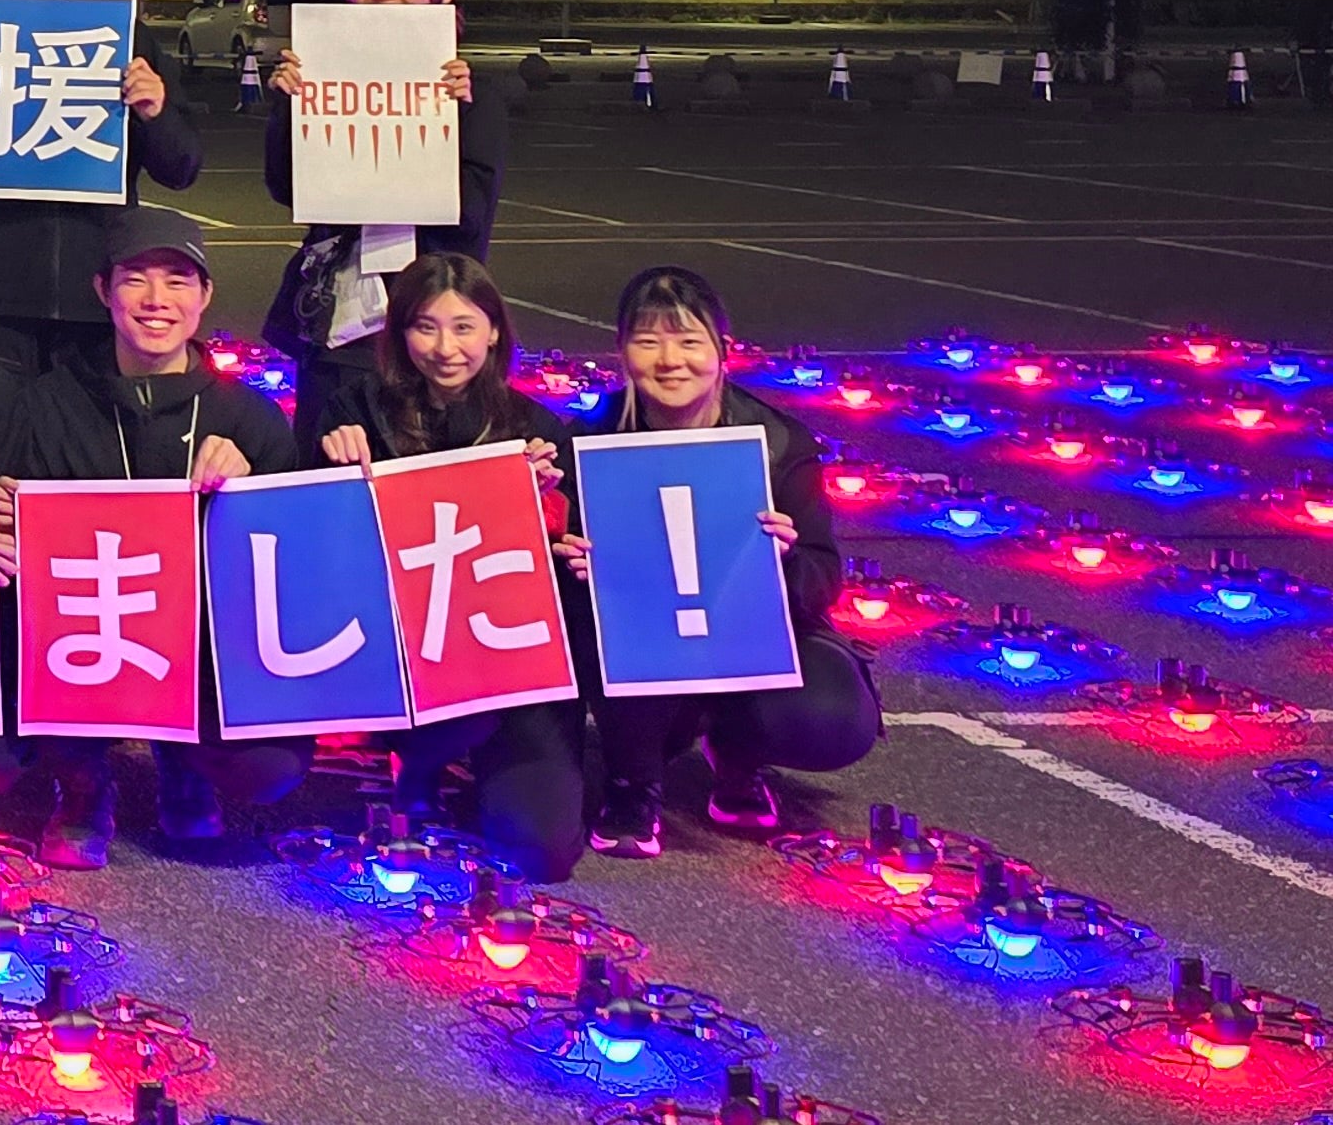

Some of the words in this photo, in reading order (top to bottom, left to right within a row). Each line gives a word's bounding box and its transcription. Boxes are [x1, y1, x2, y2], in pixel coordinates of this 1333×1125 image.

[301, 81, 359, 116] RED
[47, 531, 171, 685] ま
[250, 533, 366, 677] し
[398, 502, 550, 662] た
